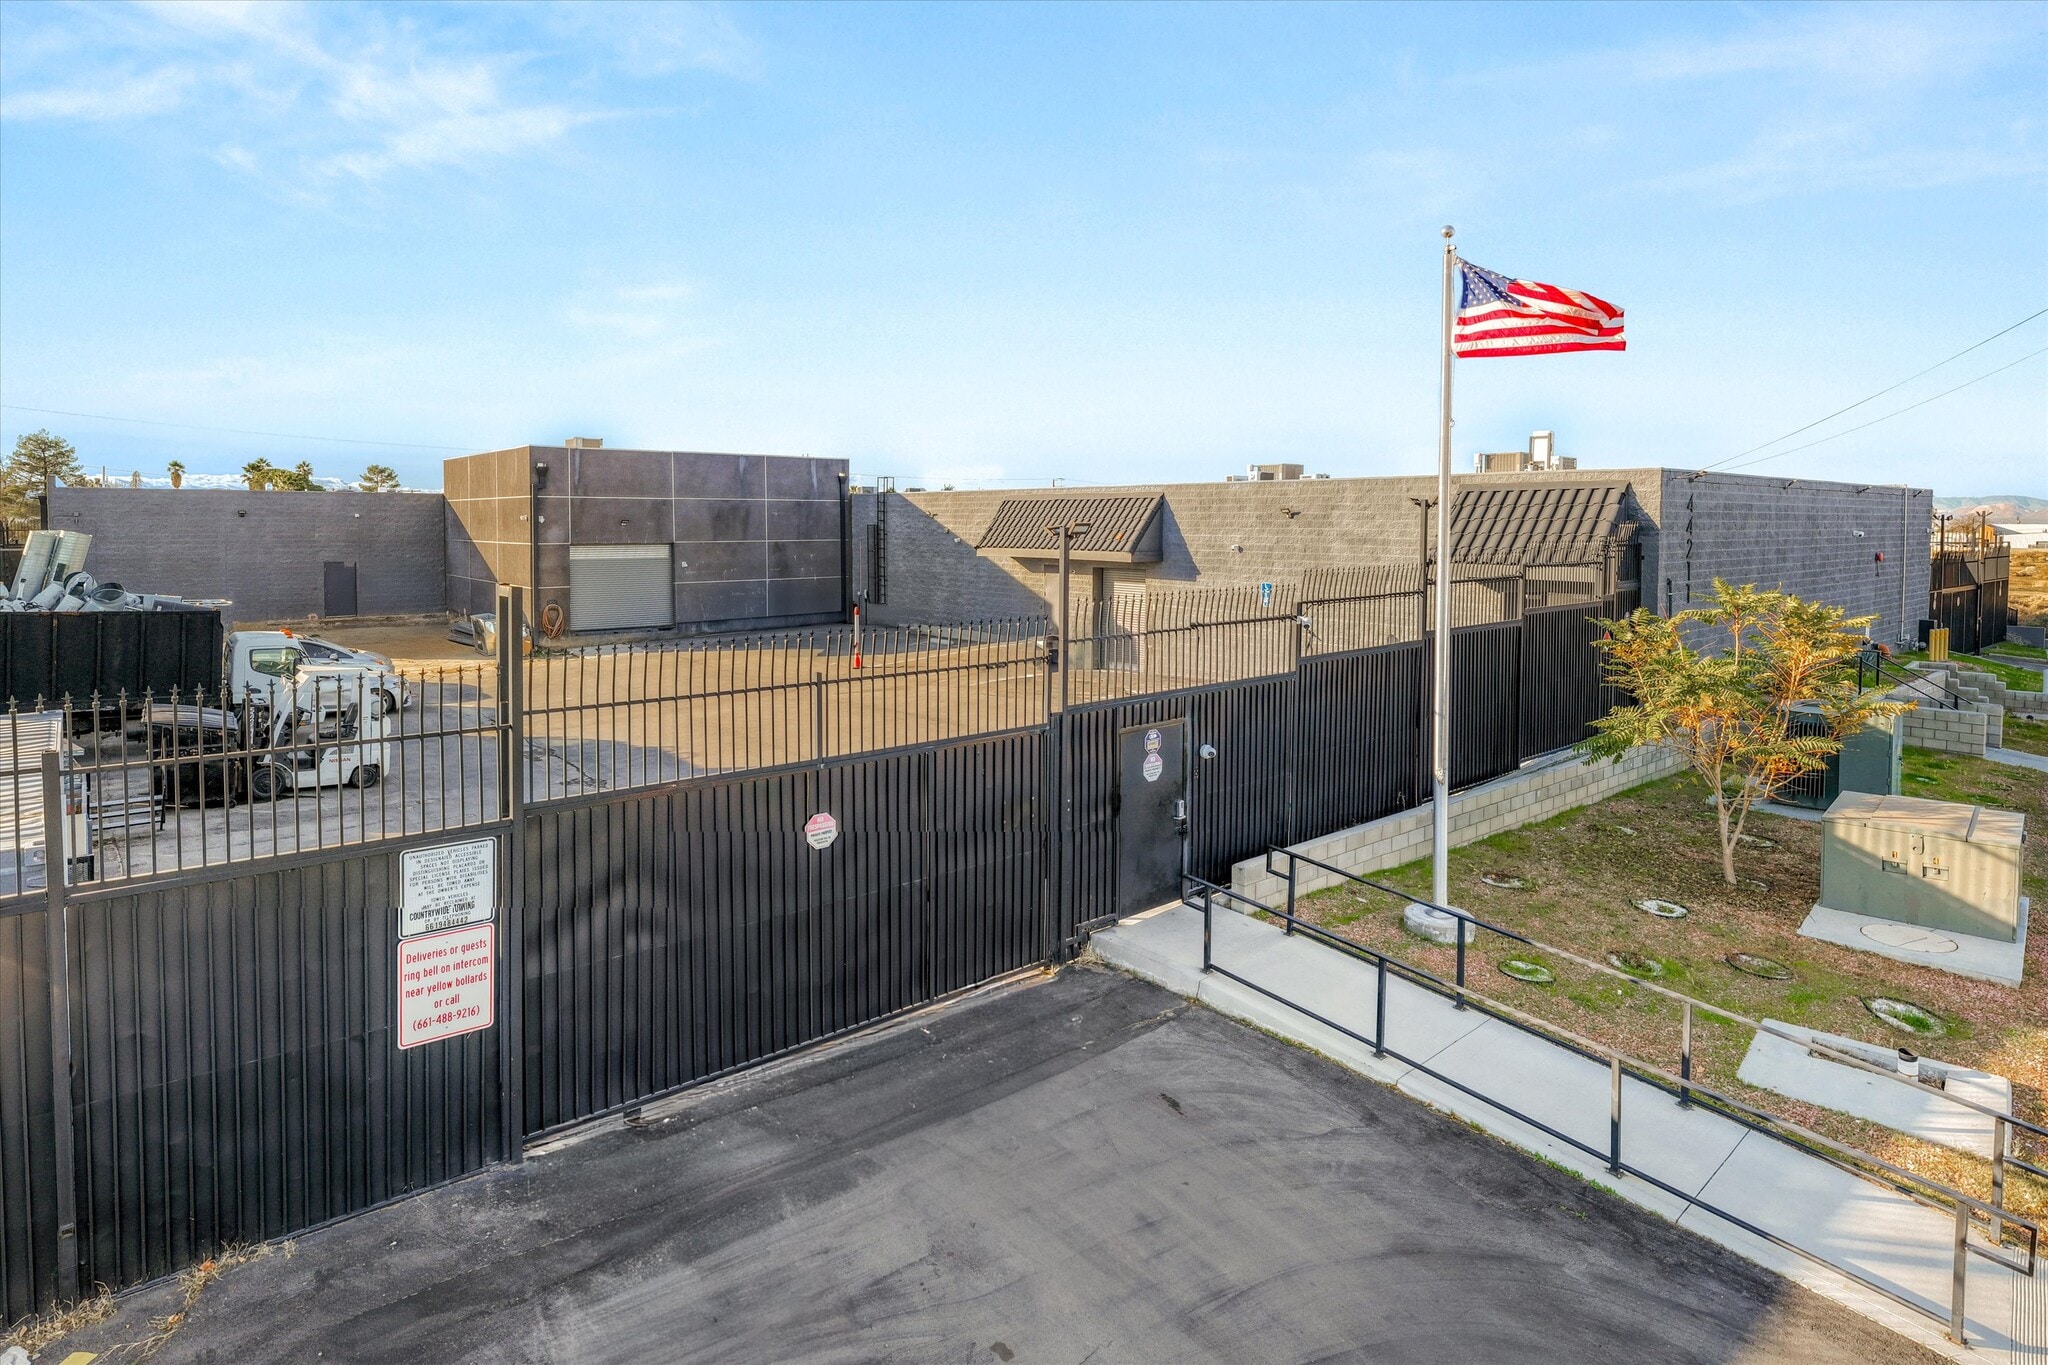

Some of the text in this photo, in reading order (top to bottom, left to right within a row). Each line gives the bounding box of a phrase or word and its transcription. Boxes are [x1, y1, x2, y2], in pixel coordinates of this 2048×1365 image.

[1685, 493, 1695, 604] 44211
[408, 850, 444, 860] UNAUTHORIZED
[448, 847, 468, 855] VEHICLES
[425, 854, 452, 863] DESIGNATED
[455, 850, 481, 858] ACCESSIBLE
[452, 856, 478, 864] DISPLAYING
[413, 866, 449, 876] DISTINGUISHING
[453, 861, 476, 869] PLACARDS
[460, 870, 488, 878] DISABILITIES
[409, 901, 475, 921] COUNTRYWIDE TOWING
[442, 911, 471, 920] TELEPHONING
[406, 939, 487, 964] Deliveries or guests
[404, 956, 488, 982] ring bell on intercom
[405, 972, 487, 998] near yellow bollards
[434, 994, 460, 1008] or call
[412, 1005, 480, 1031] (661-488-9216)
